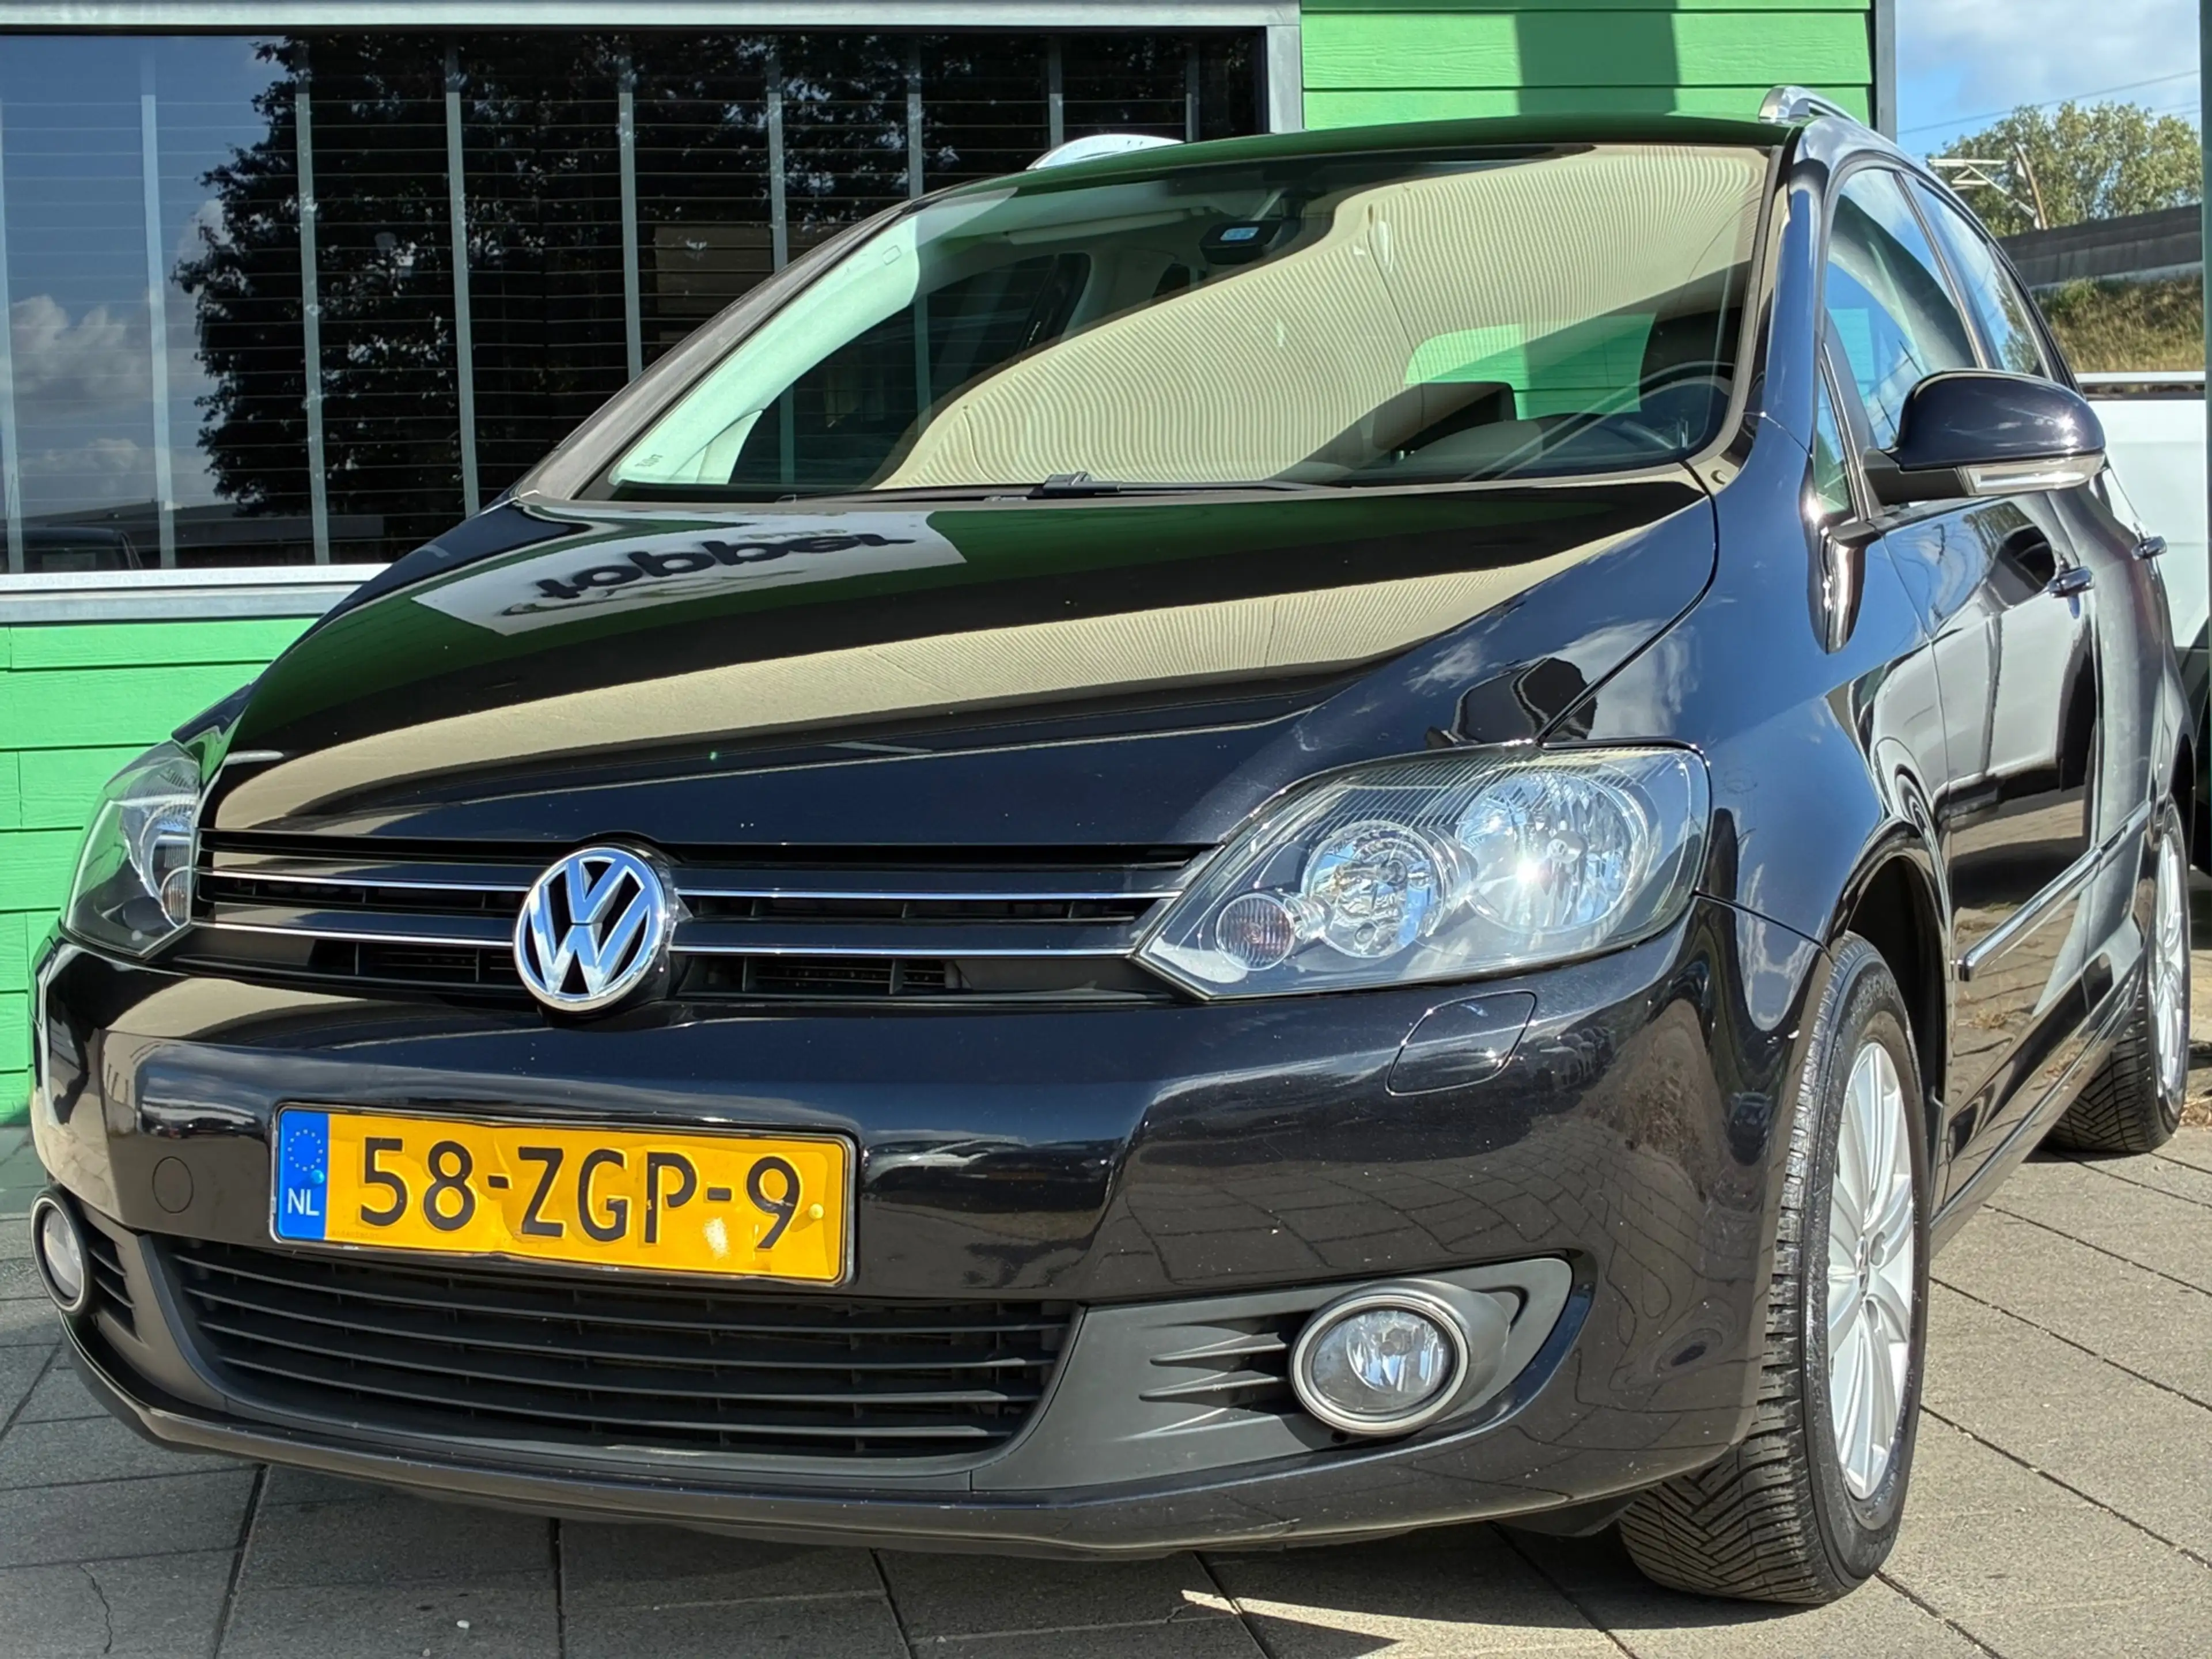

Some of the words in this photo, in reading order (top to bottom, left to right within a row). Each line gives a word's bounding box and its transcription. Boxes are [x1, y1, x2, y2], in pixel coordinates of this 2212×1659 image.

[521, 851, 655, 999] VW
[287, 1187, 320, 1217] NL
[359, 1137, 801, 1250] 58-ZGP-9
